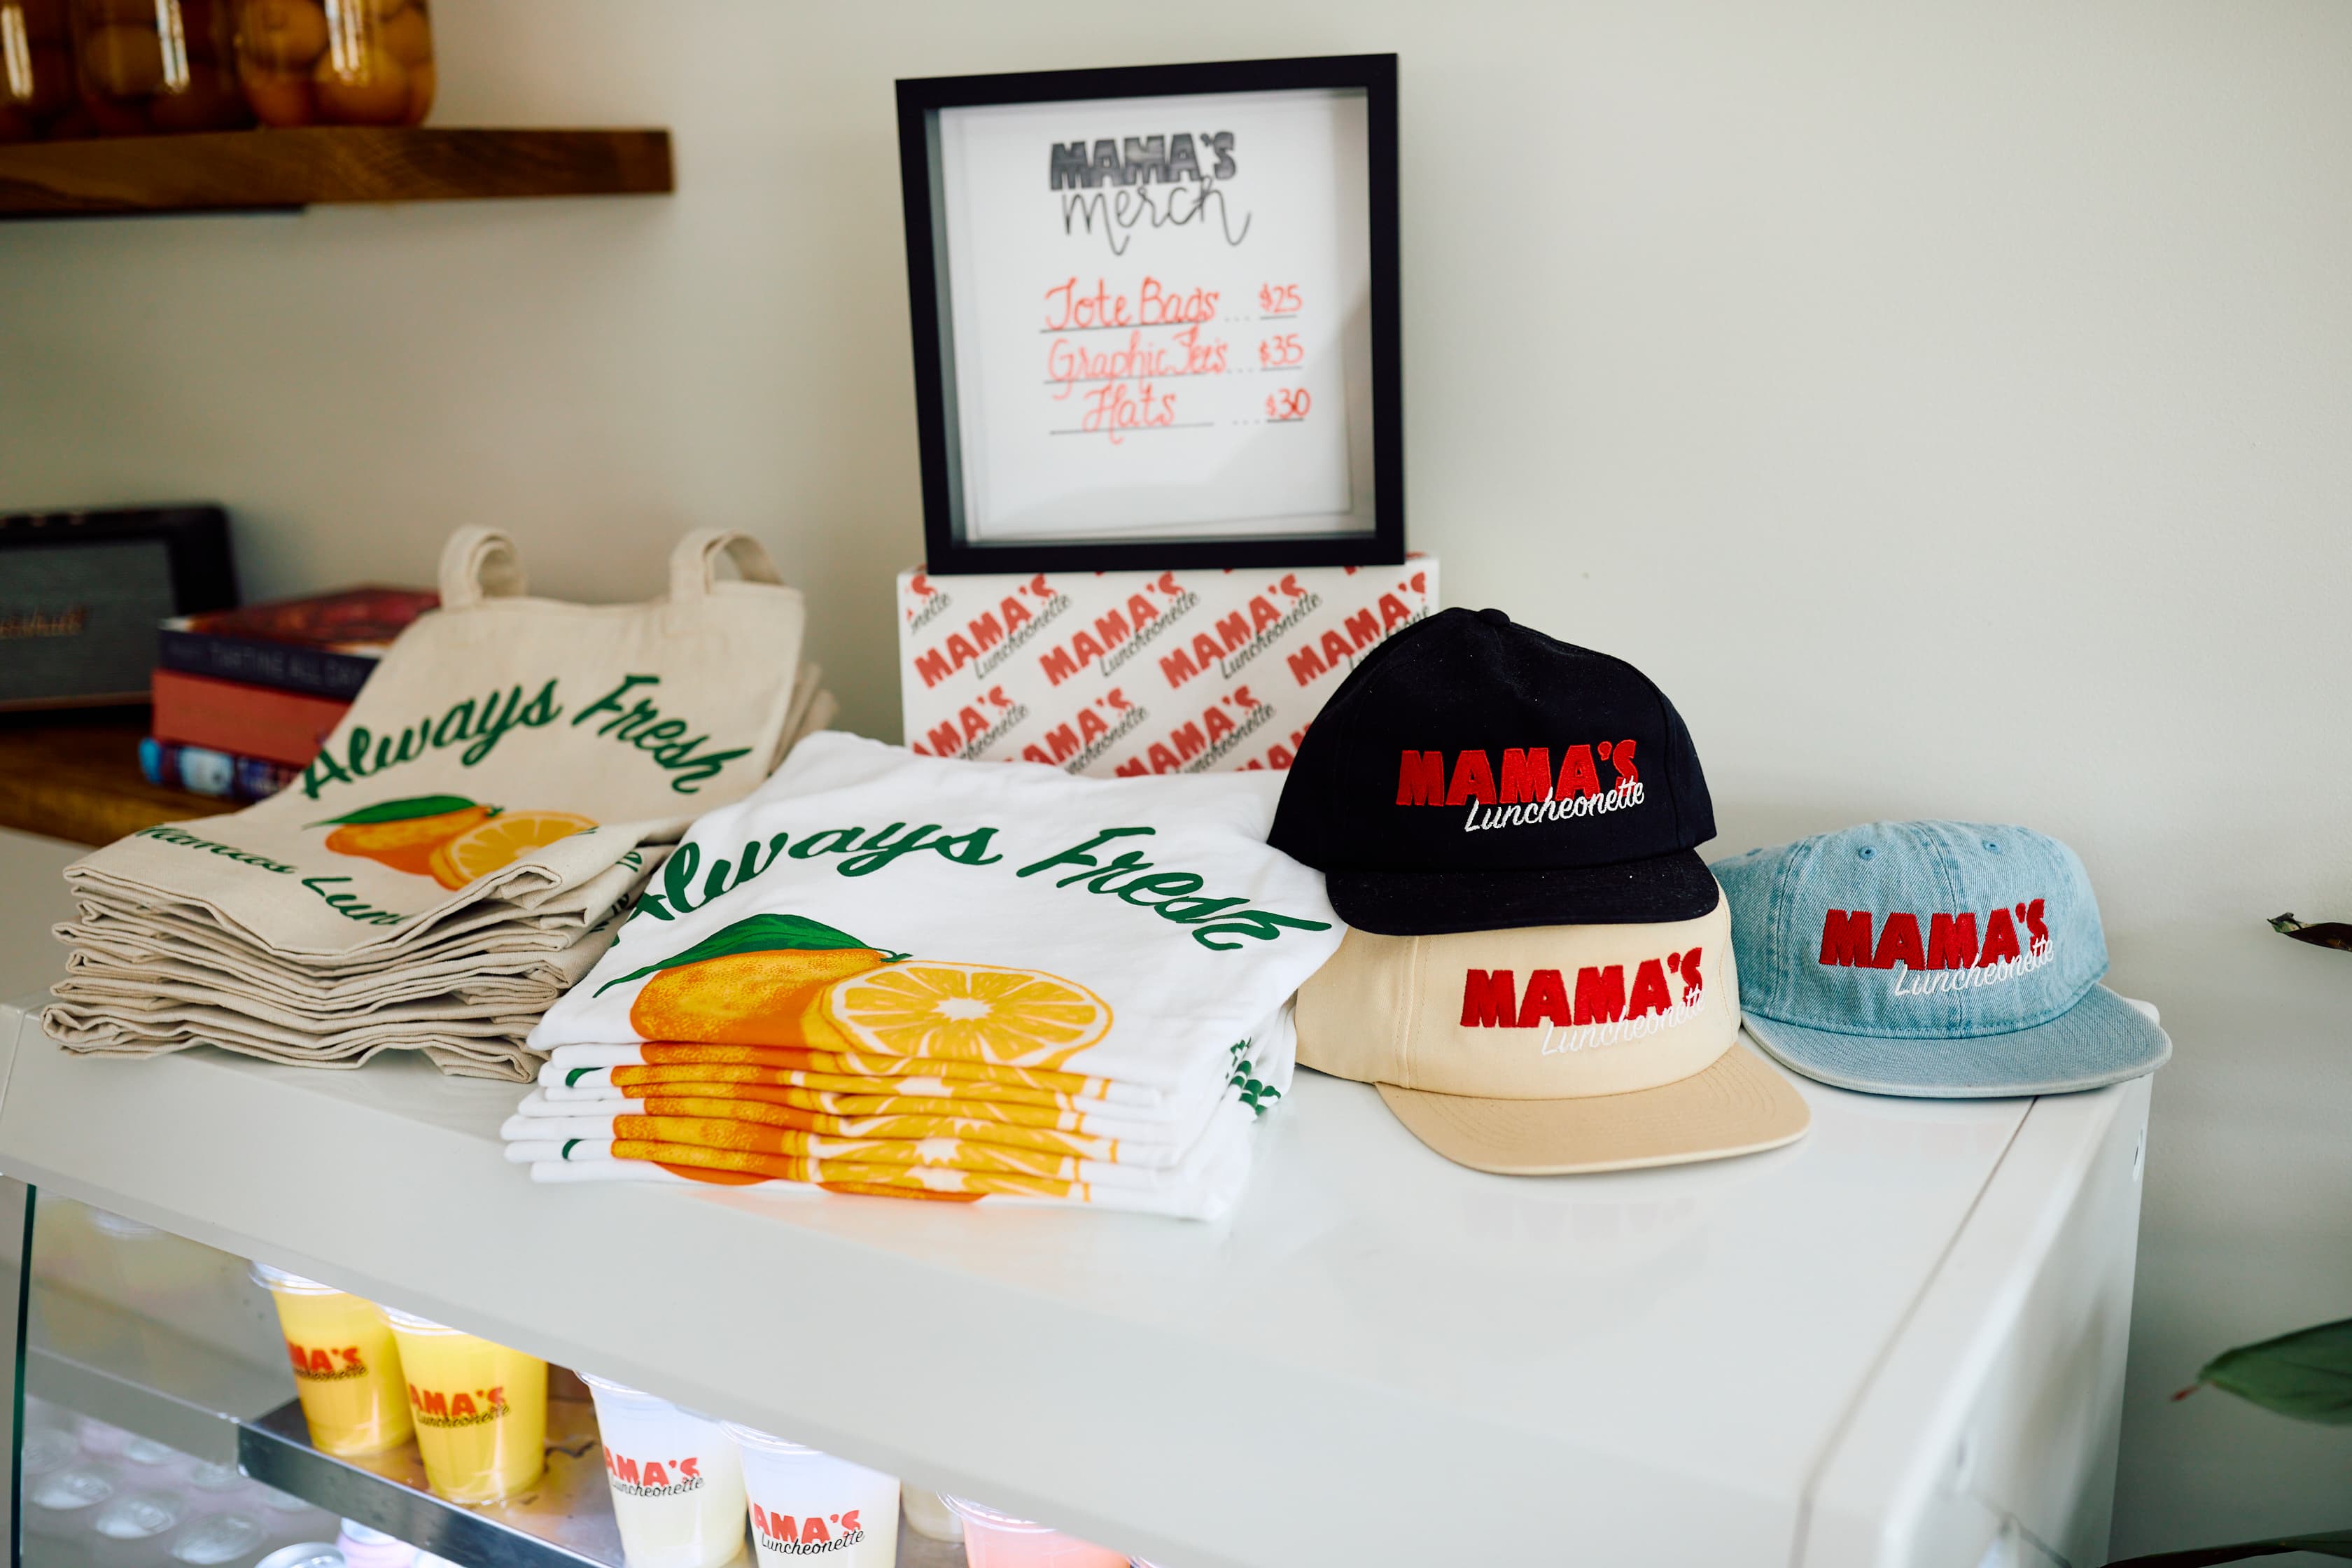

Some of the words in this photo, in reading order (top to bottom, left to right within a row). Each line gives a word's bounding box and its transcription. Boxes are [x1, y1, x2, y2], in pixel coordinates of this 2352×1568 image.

[1050, 130, 1237, 191] MAMA'S
[1061, 176, 1252, 256] merch
[1044, 276, 1132, 330] Tote
[1139, 276, 1219, 325] Bags
[1258, 283, 1303, 314] $25
[1049, 328, 1172, 400] Graphic
[1259, 334, 1304, 368] $35
[1082, 383, 1176, 444] Hats
[1266, 388, 1311, 420] $30
[913, 573, 1058, 689] MAMA'S
[974, 594, 1071, 680] Luncheonette
[1039, 570, 1186, 687] MAMA'S
[1100, 592, 1200, 678] Luncheonette
[1159, 572, 1308, 690] MAMA'S
[1219, 593, 1322, 680] Luncheonette
[300, 678, 563, 801] Always
[571, 674, 752, 794] Fresh
[1396, 738, 1639, 807] MAMA'S
[1464, 776, 1645, 832] Luncheonette
[1017, 827, 1333, 951] Fresh
[1819, 898, 2049, 970] MAMA'S
[1894, 934, 2054, 997] Luncheonette
[1460, 947, 1703, 1028] MAMA'S
[1541, 983, 1707, 1056] Luncheonette
[409, 1382, 505, 1418] AMA'S
[604, 1444, 700, 1488] AMA'S
[749, 1500, 862, 1545] AMA'S
[762, 1529, 865, 1555] Luncheonette
